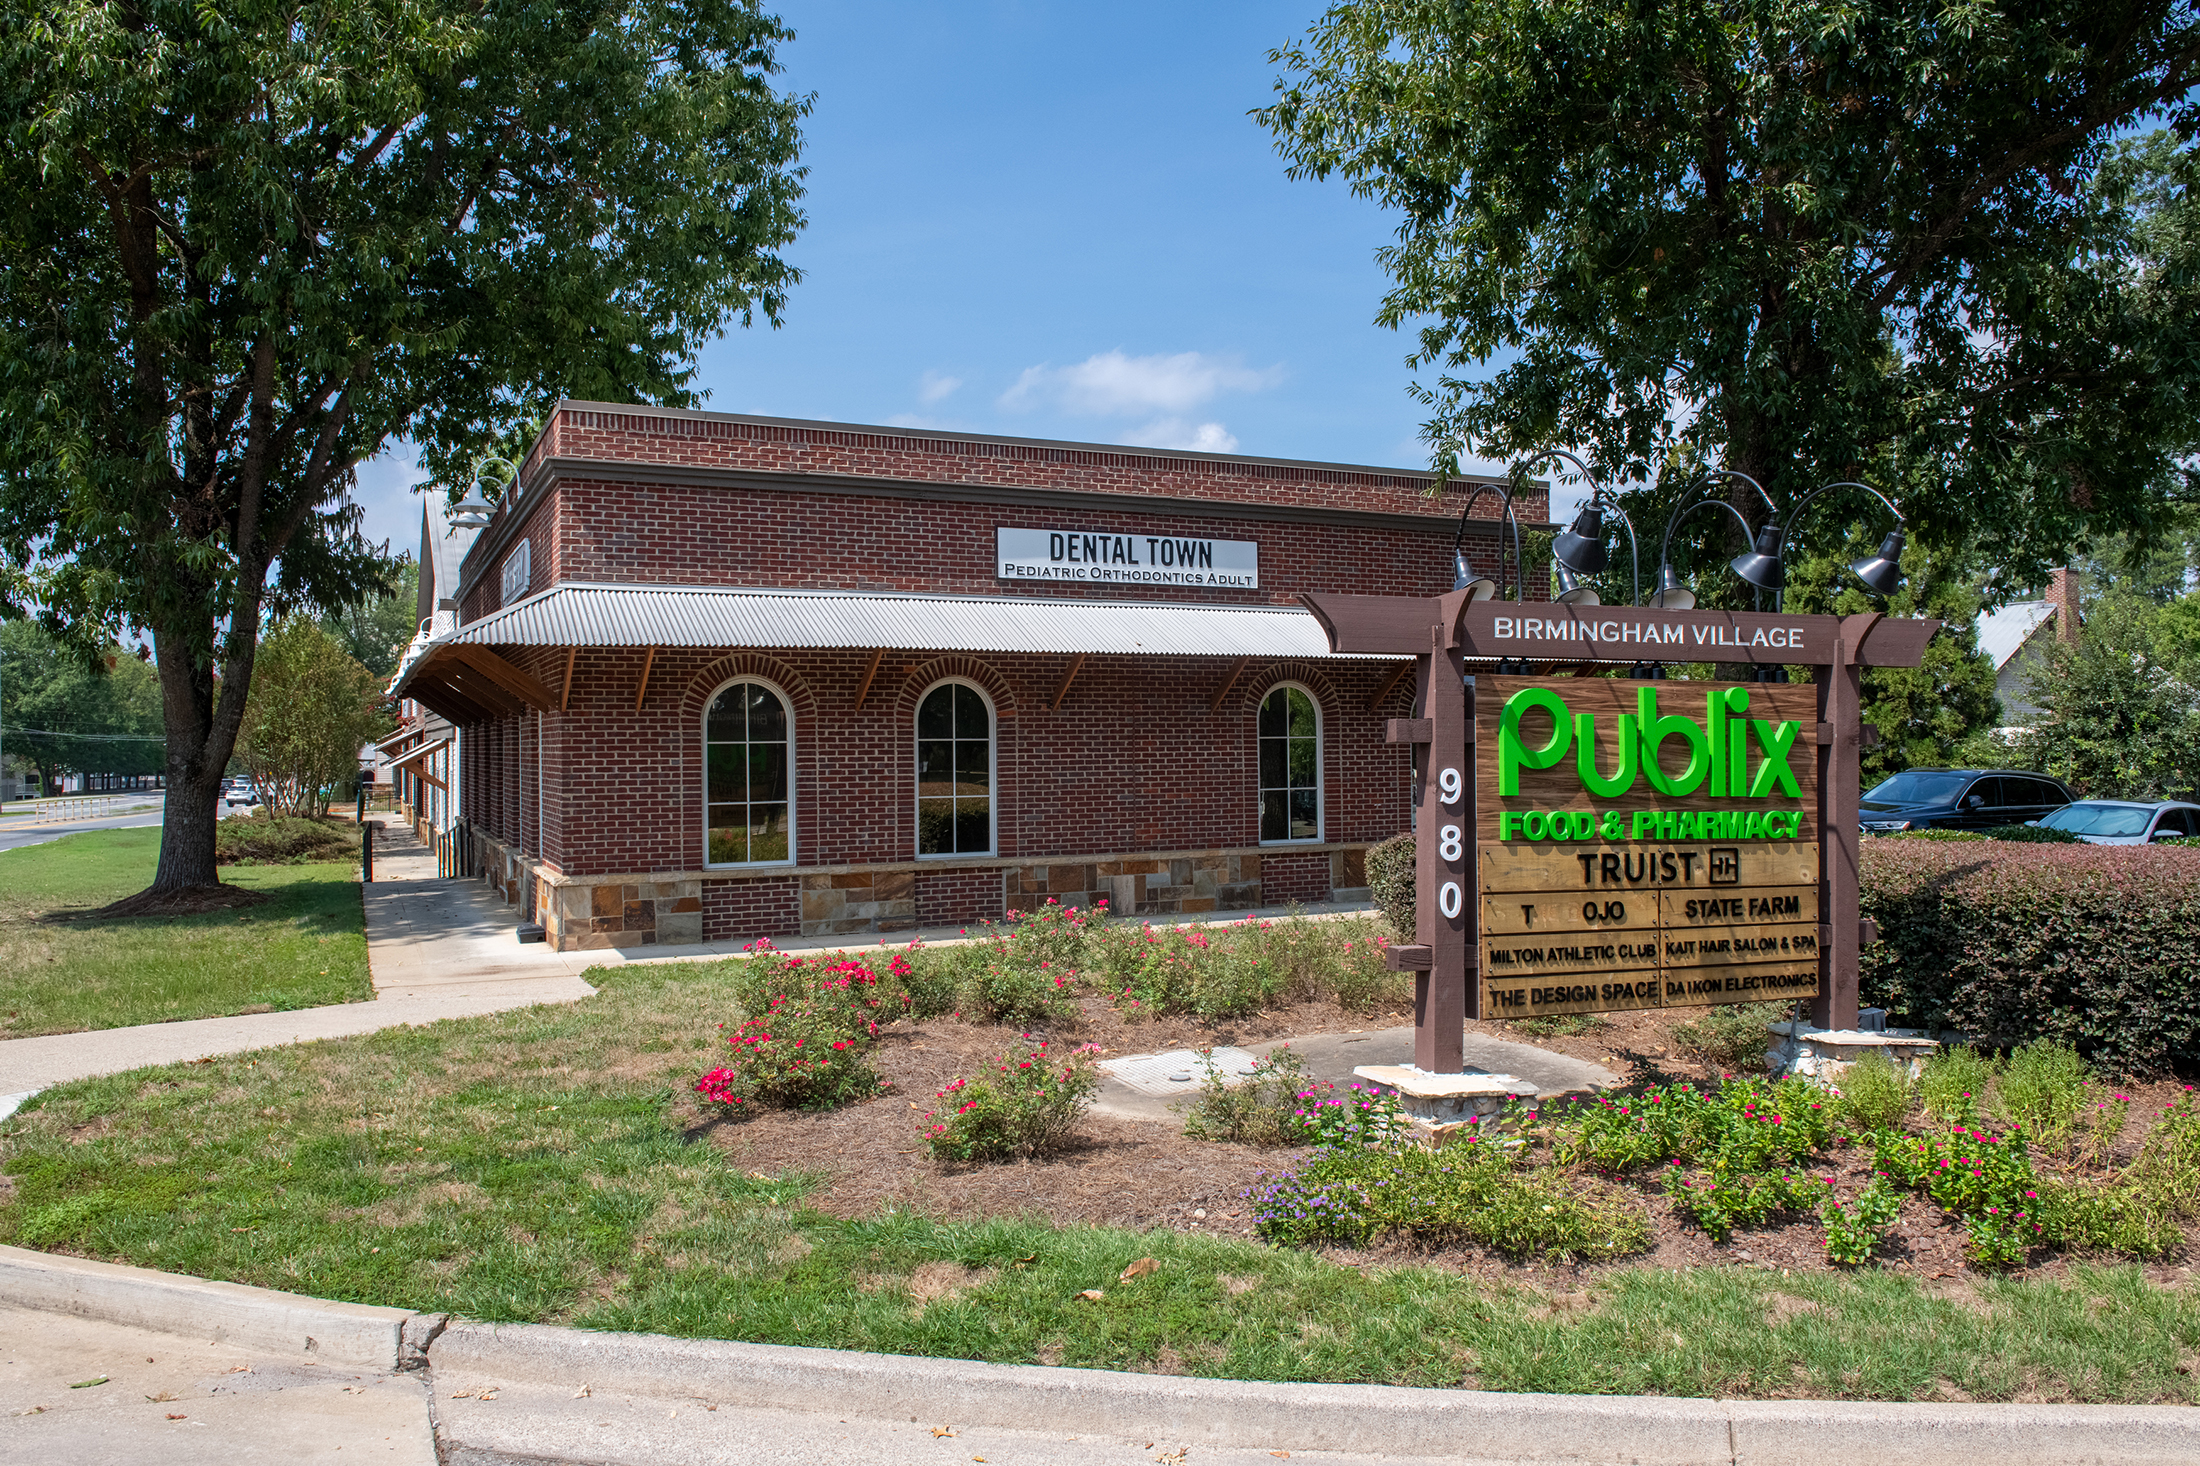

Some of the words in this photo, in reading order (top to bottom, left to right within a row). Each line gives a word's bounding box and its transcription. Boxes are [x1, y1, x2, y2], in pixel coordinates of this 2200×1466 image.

[1050, 533, 1139, 565] DENTAL
[1146, 537, 1212, 569] TOWN
[1004, 563, 1085, 579] PEDIATRIC
[1090, 567, 1203, 584] ORTHODONTICS
[1207, 573, 1252, 586] ADULT
[1494, 617, 1684, 644] BIRMINGHAM
[1691, 624, 1804, 648] VILLAGE
[1499, 687, 1803, 797] Publix
[1500, 811, 1596, 841] FOOD
[1600, 811, 1625, 841] &
[1632, 810, 1804, 840] PHARMACY
[1577, 852, 1697, 883] TRUIST
[1685, 898, 1743, 918] STATE
[1749, 895, 1799, 915] FARM
[1490, 948, 1543, 964] MILTON
[1547, 945, 1614, 962] ATHLETIC
[1618, 944, 1656, 958] CLUB
[1665, 940, 1696, 955] KAIT
[1699, 939, 1731, 953] HAIR
[1733, 937, 1777, 951] SALON
[1780, 936, 1789, 949] &
[1792, 935, 1817, 948] SPA
[1489, 989, 1525, 1007] THE
[1530, 985, 1597, 1005] DESIGN
[1601, 981, 1658, 1000] SPACE
[1725, 972, 1817, 991] ELECTRONICS
